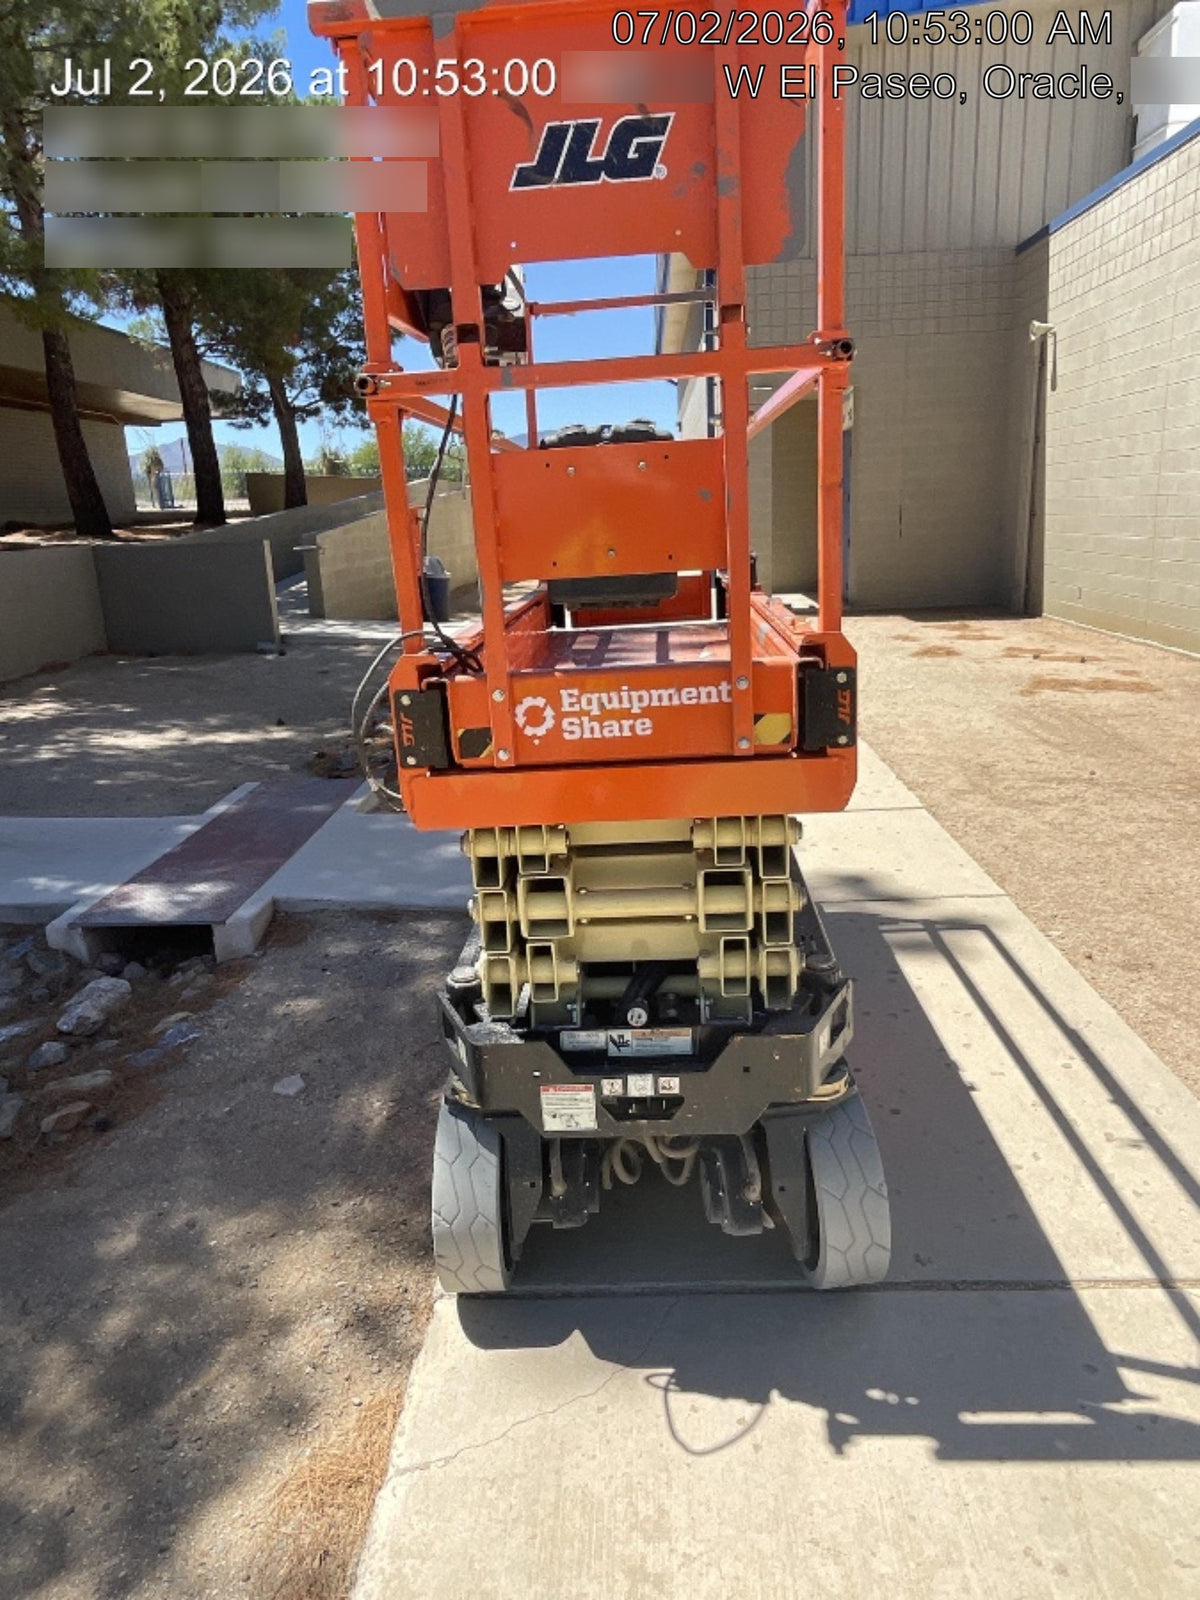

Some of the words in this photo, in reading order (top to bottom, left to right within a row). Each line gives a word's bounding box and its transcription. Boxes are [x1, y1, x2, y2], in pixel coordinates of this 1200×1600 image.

[508, 111, 677, 193] JLG
[559, 680, 733, 716] Equipment
[400, 711, 416, 748] JLG
[560, 716, 653, 741] Share
